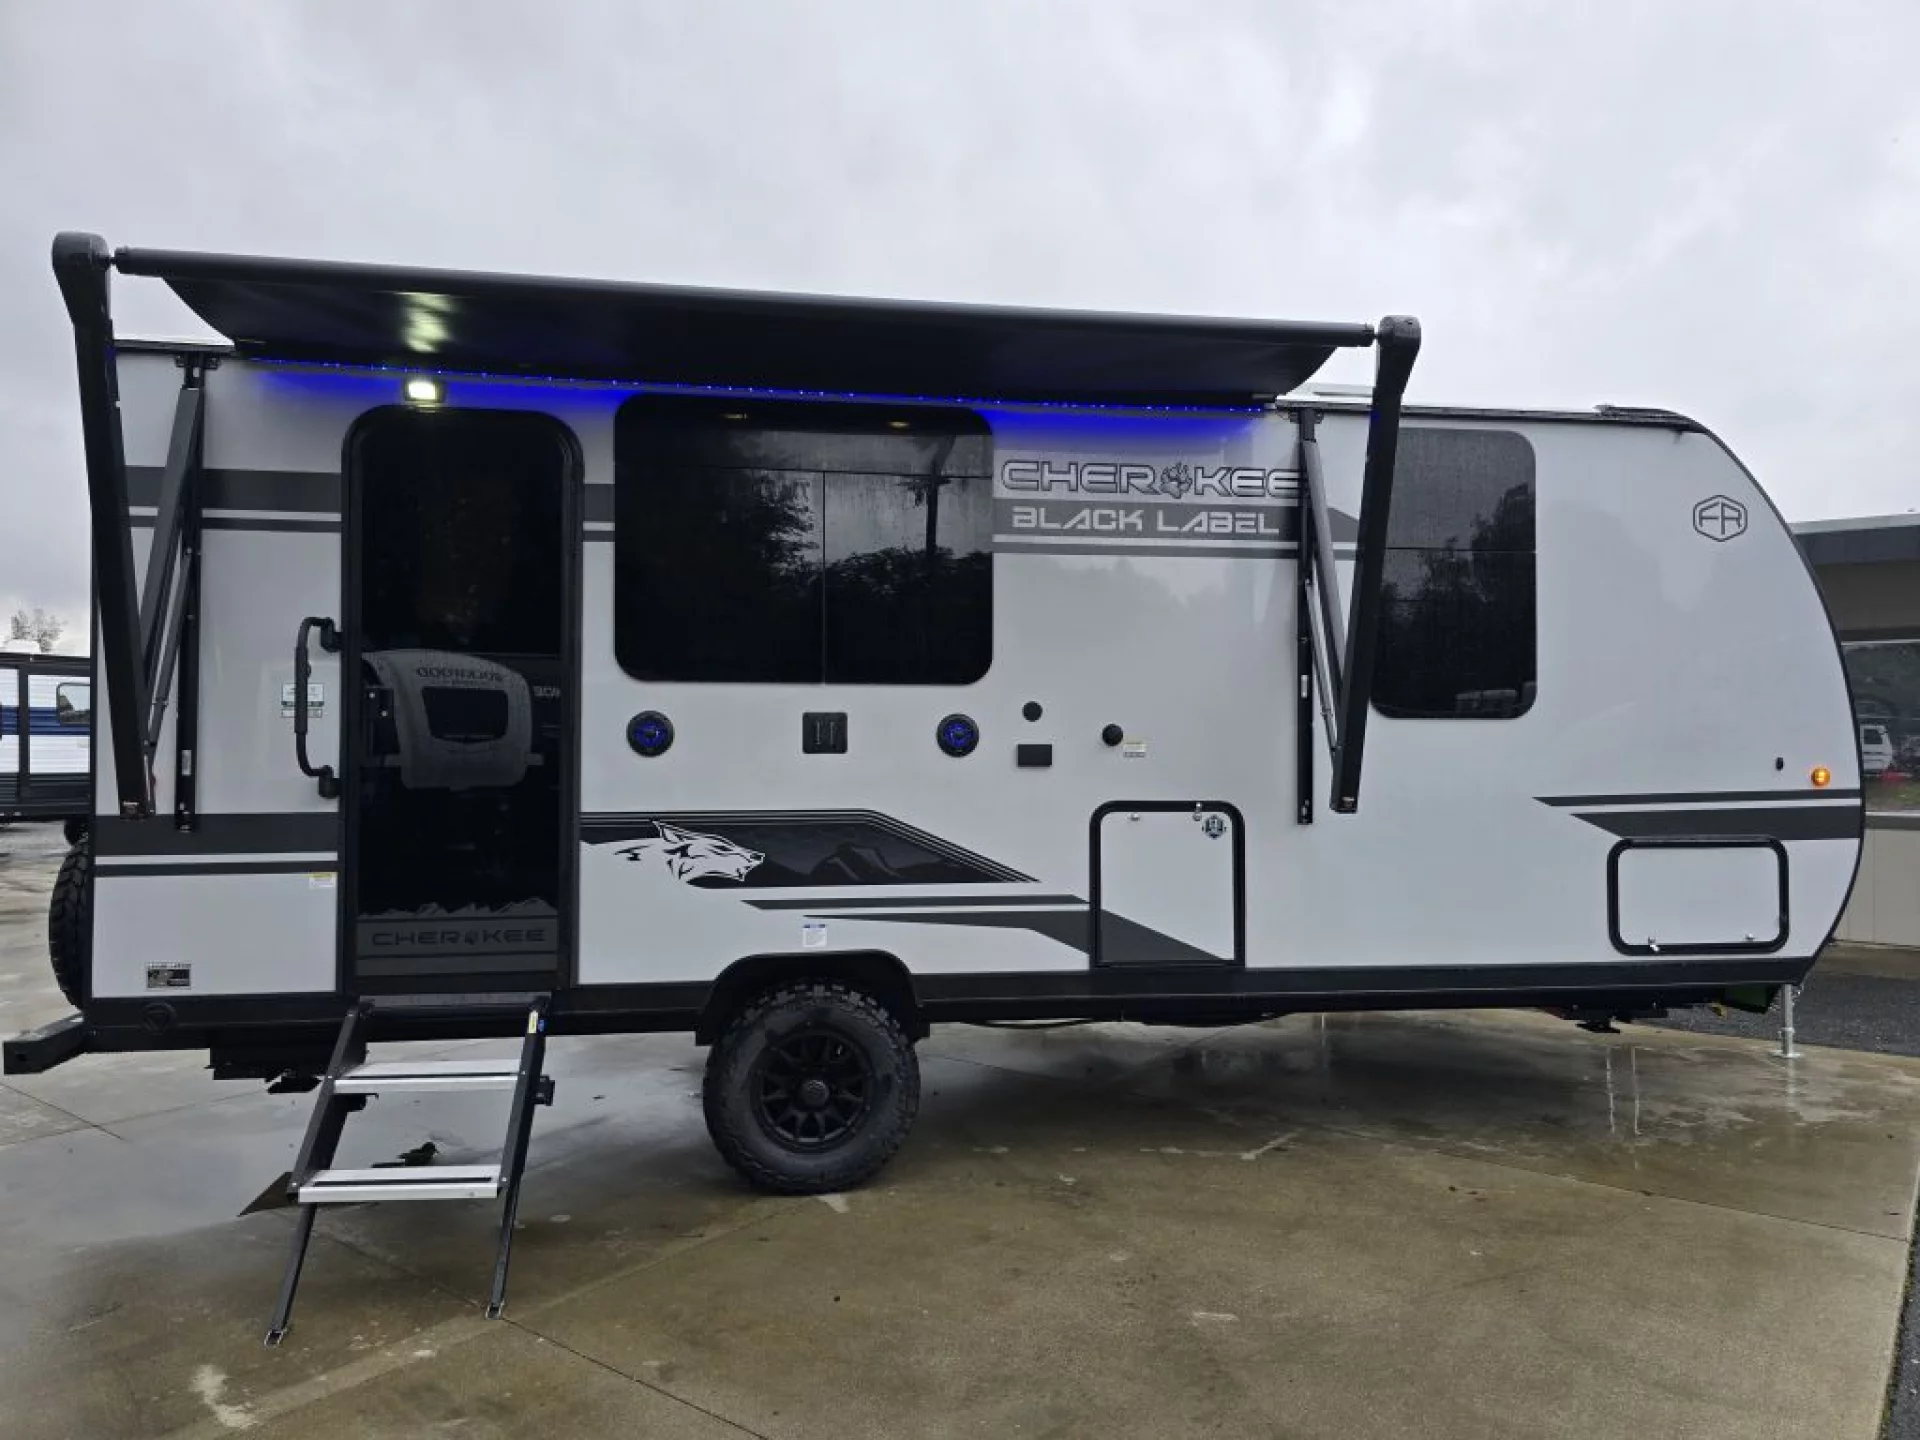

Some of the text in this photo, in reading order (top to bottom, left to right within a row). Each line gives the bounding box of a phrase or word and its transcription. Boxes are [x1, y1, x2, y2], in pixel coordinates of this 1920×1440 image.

[1012, 506, 1279, 535] BLACK LABEL
[1699, 500, 1742, 535] FR
